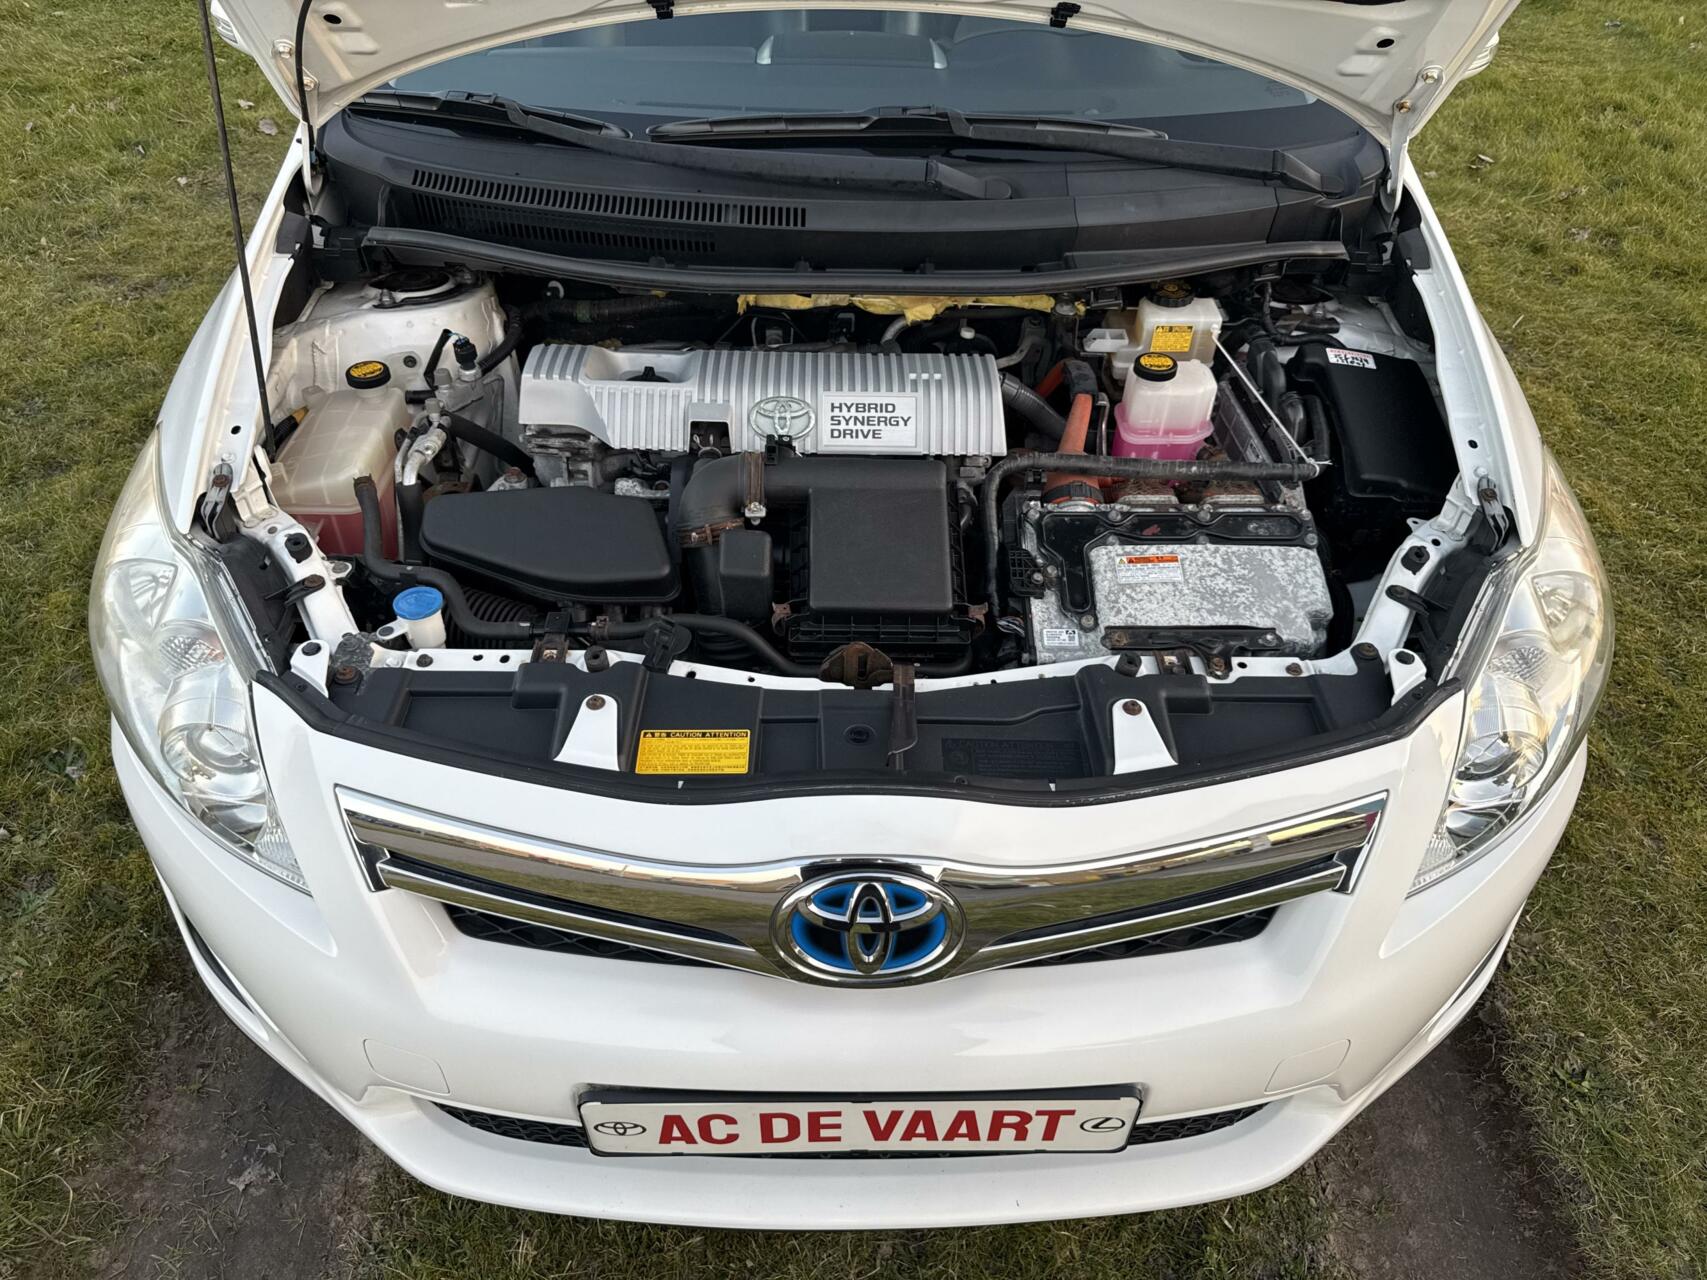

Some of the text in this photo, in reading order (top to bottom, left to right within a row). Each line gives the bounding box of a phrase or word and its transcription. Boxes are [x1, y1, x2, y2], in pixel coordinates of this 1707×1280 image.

[830, 402, 896, 413] HYBRID
[830, 415, 911, 426] SYNERGY
[830, 428, 882, 439] DRIVE
[658, 1109, 1077, 1145] AC DE VAART
